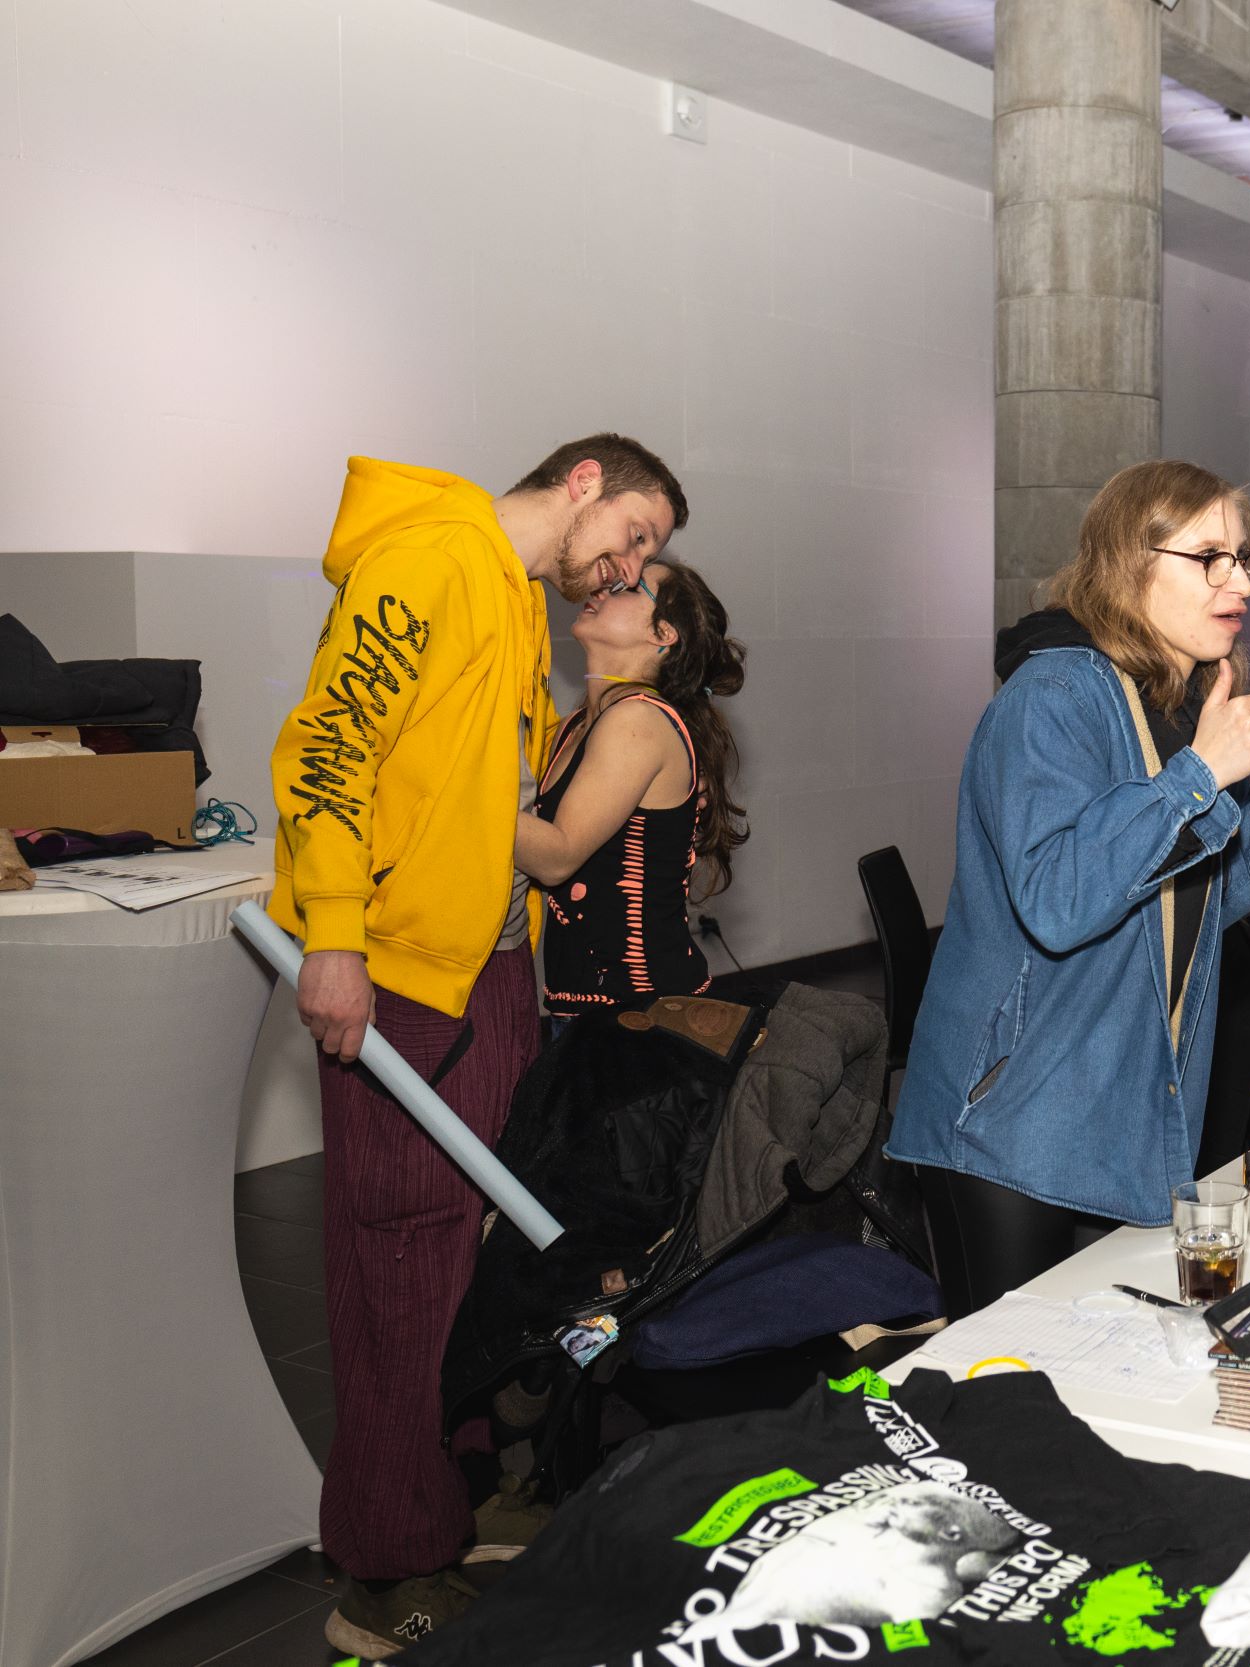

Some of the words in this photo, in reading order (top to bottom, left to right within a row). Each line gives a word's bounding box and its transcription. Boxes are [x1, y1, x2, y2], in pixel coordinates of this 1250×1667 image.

[177, 827, 187, 840] L
[704, 1463, 920, 1574] TRESPASSING
[947, 1570, 1029, 1622] THIS
